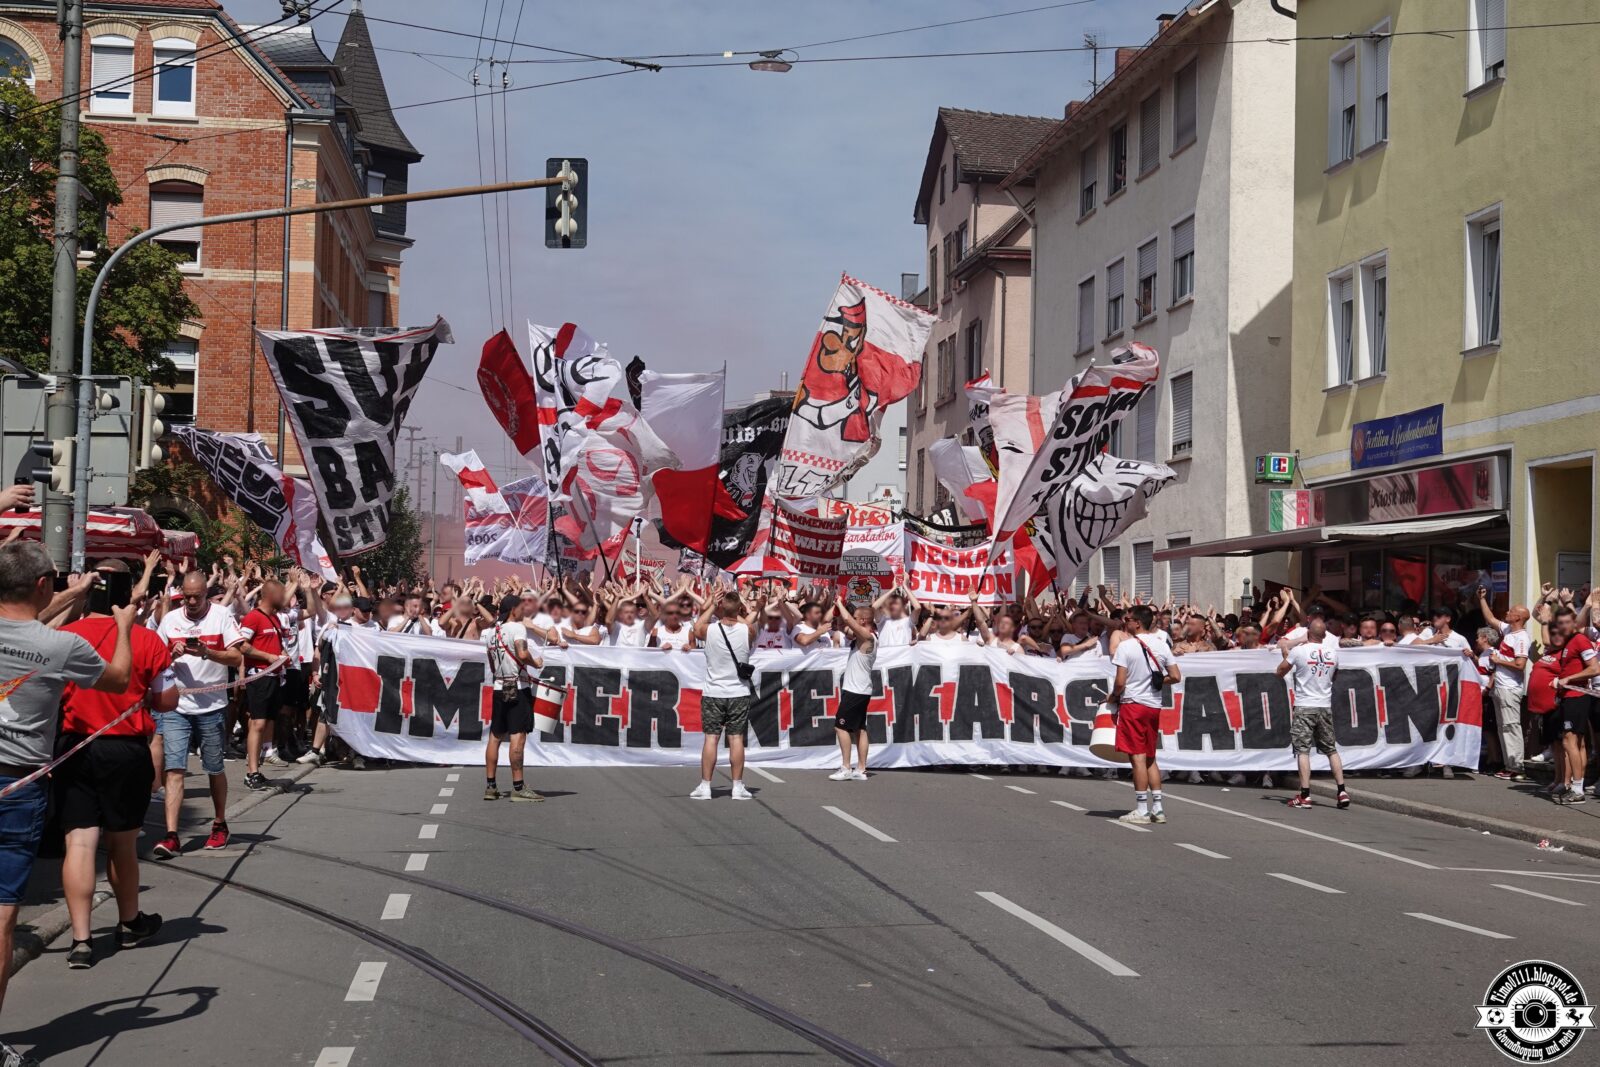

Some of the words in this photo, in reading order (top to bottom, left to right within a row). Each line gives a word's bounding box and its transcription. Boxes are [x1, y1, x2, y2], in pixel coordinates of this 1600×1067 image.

[1371, 484, 1397, 508] Kiosk
[795, 534, 840, 552] WAFFE
[847, 562, 877, 571] ULTRAS
[909, 569, 1013, 596] STADION
[725, 662, 1459, 751] NEKARSADON!
